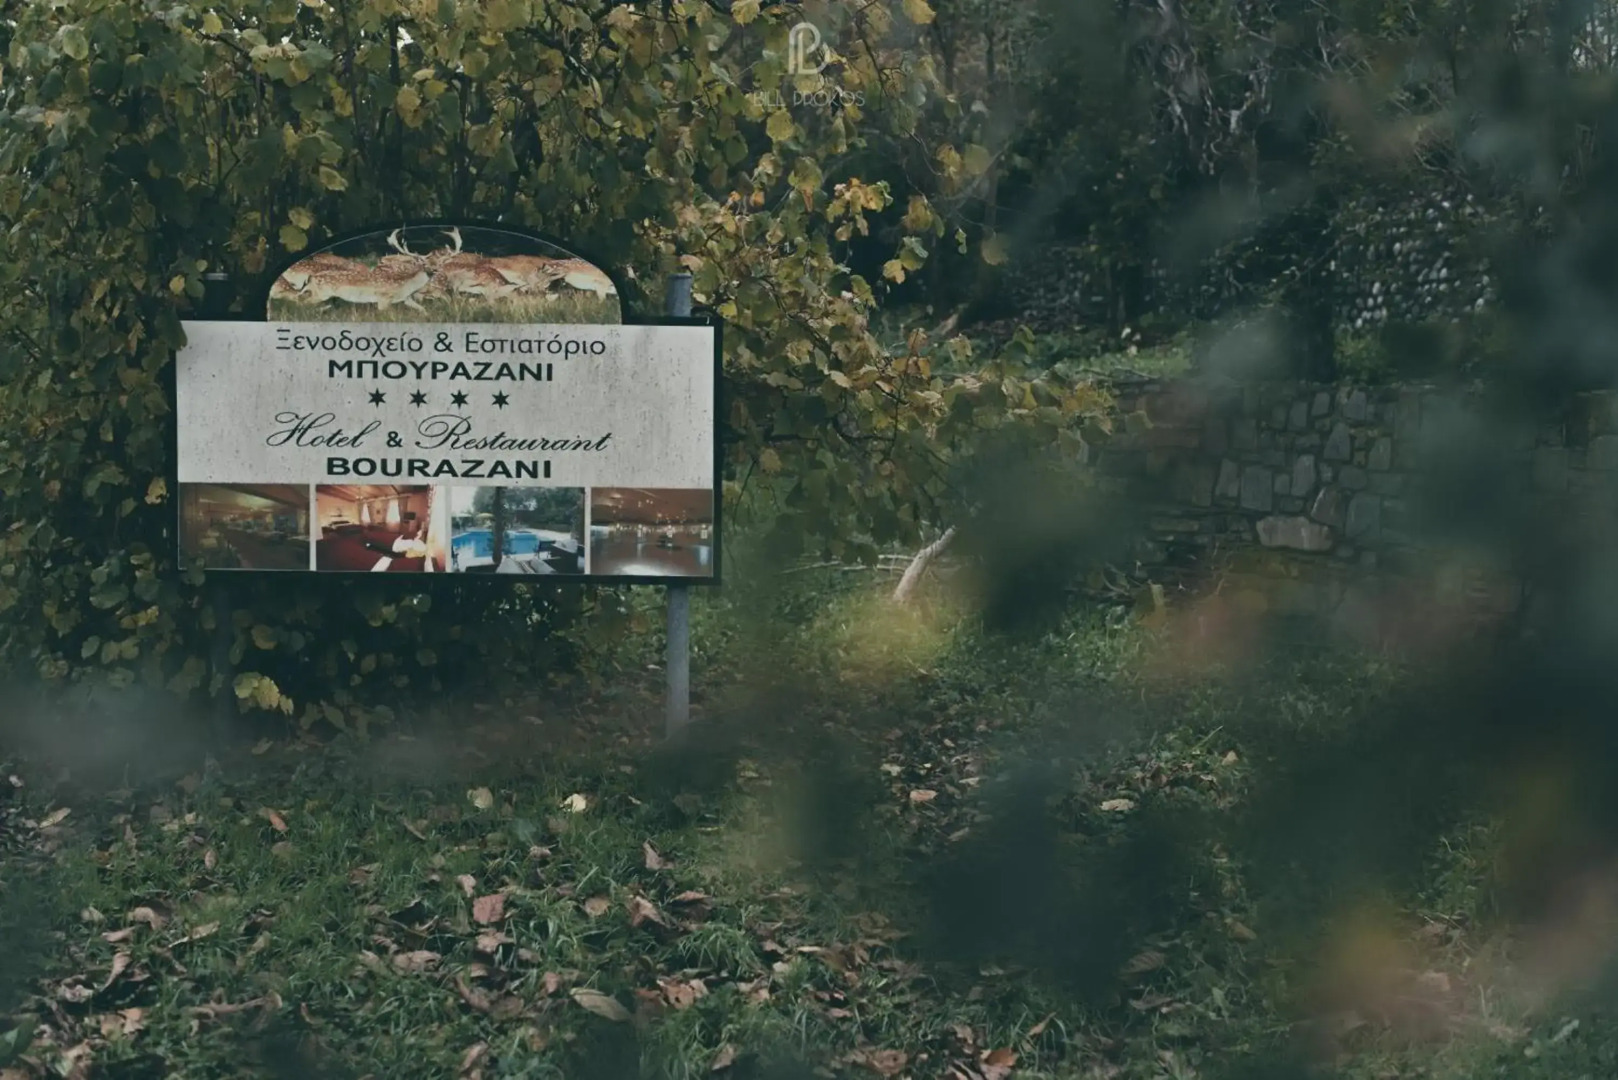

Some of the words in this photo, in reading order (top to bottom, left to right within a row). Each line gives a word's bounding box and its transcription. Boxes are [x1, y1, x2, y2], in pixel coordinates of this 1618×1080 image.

[275, 329, 424, 357] Ξενοδοχείο
[433, 332, 454, 353] &
[465, 331, 607, 360] Εστιατόριο
[328, 359, 554, 382] ΜΠΟΥΡΑΖΑΝΙ
[266, 411, 382, 448] Hotel
[386, 430, 403, 448] &
[414, 414, 613, 451] Restaurant
[326, 457, 552, 479] BOURAZANI
